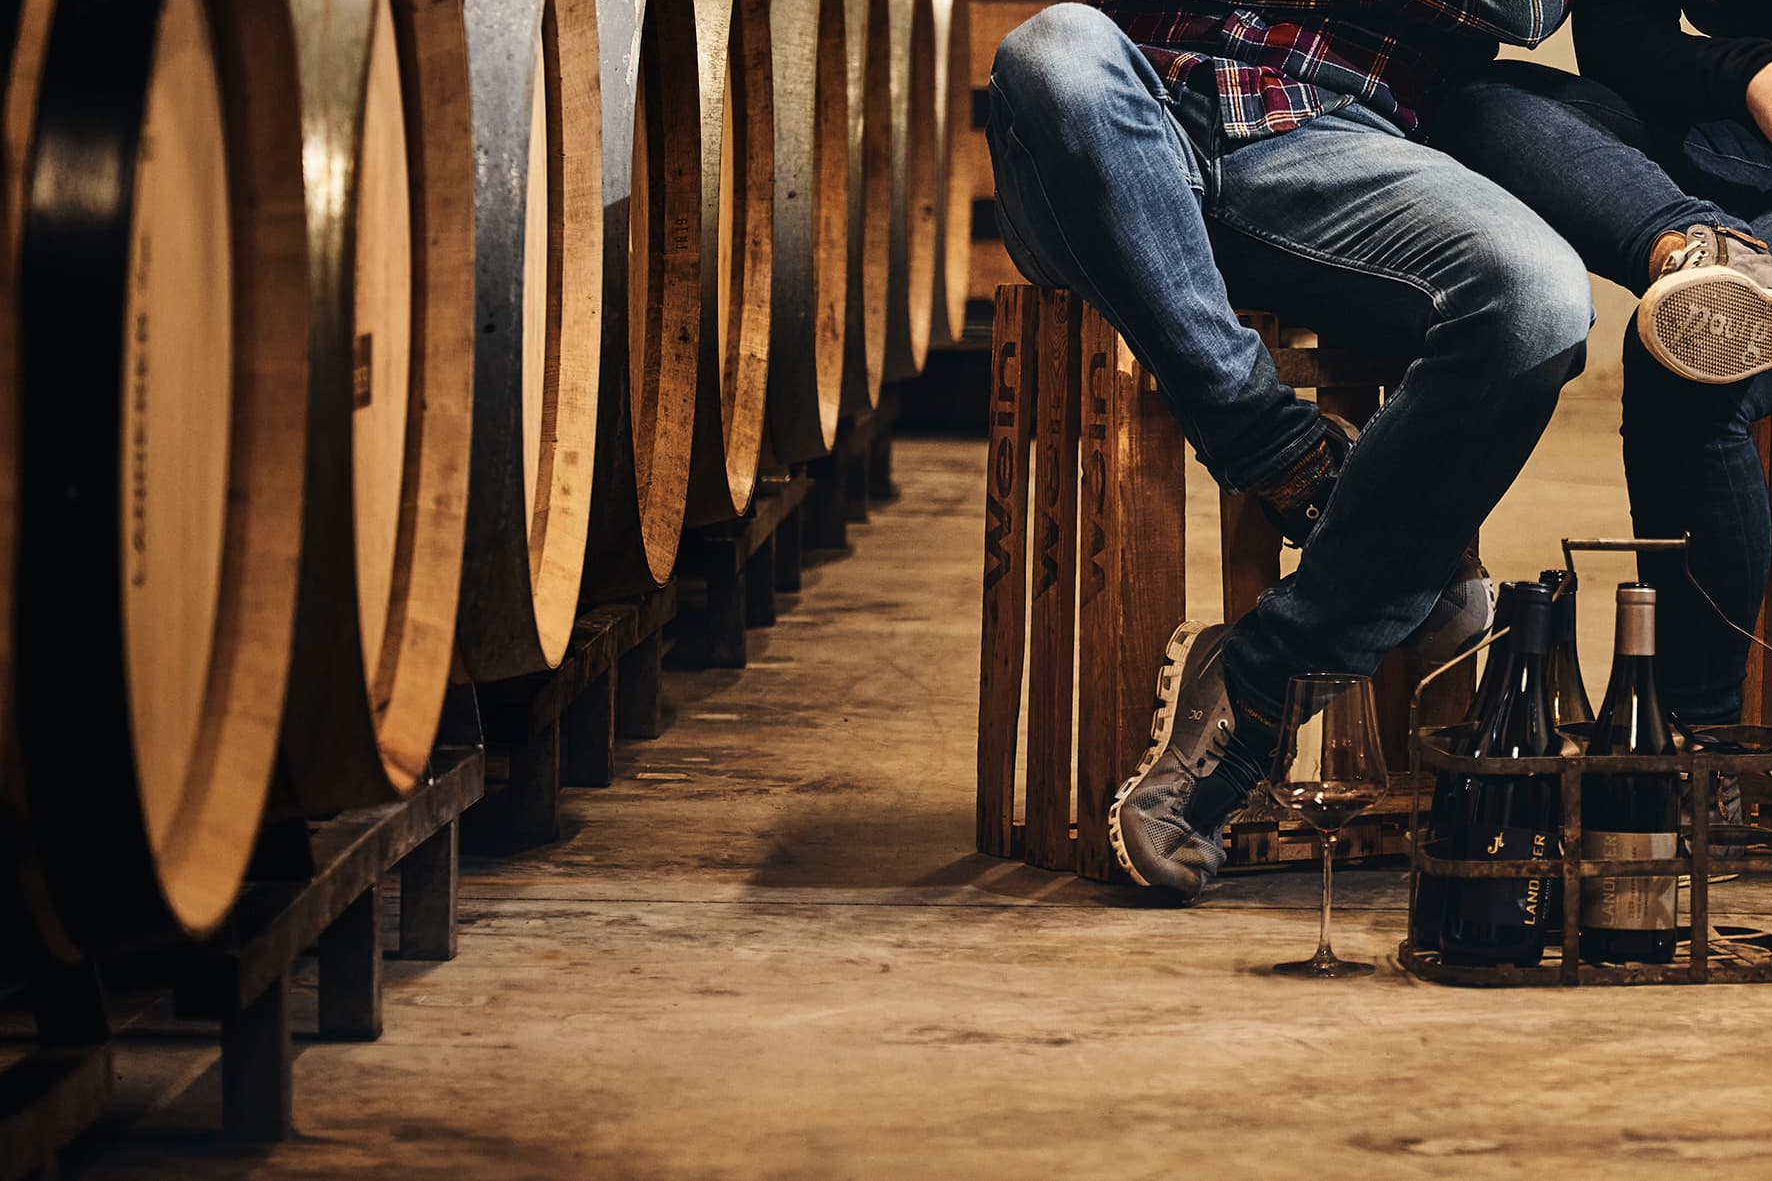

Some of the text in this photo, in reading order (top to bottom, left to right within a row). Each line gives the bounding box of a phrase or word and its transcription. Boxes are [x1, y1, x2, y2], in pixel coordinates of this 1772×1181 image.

[984, 341, 1016, 593] Wein
[1524, 834, 1546, 925] LANDER
[1602, 834, 1618, 925] LANDER
